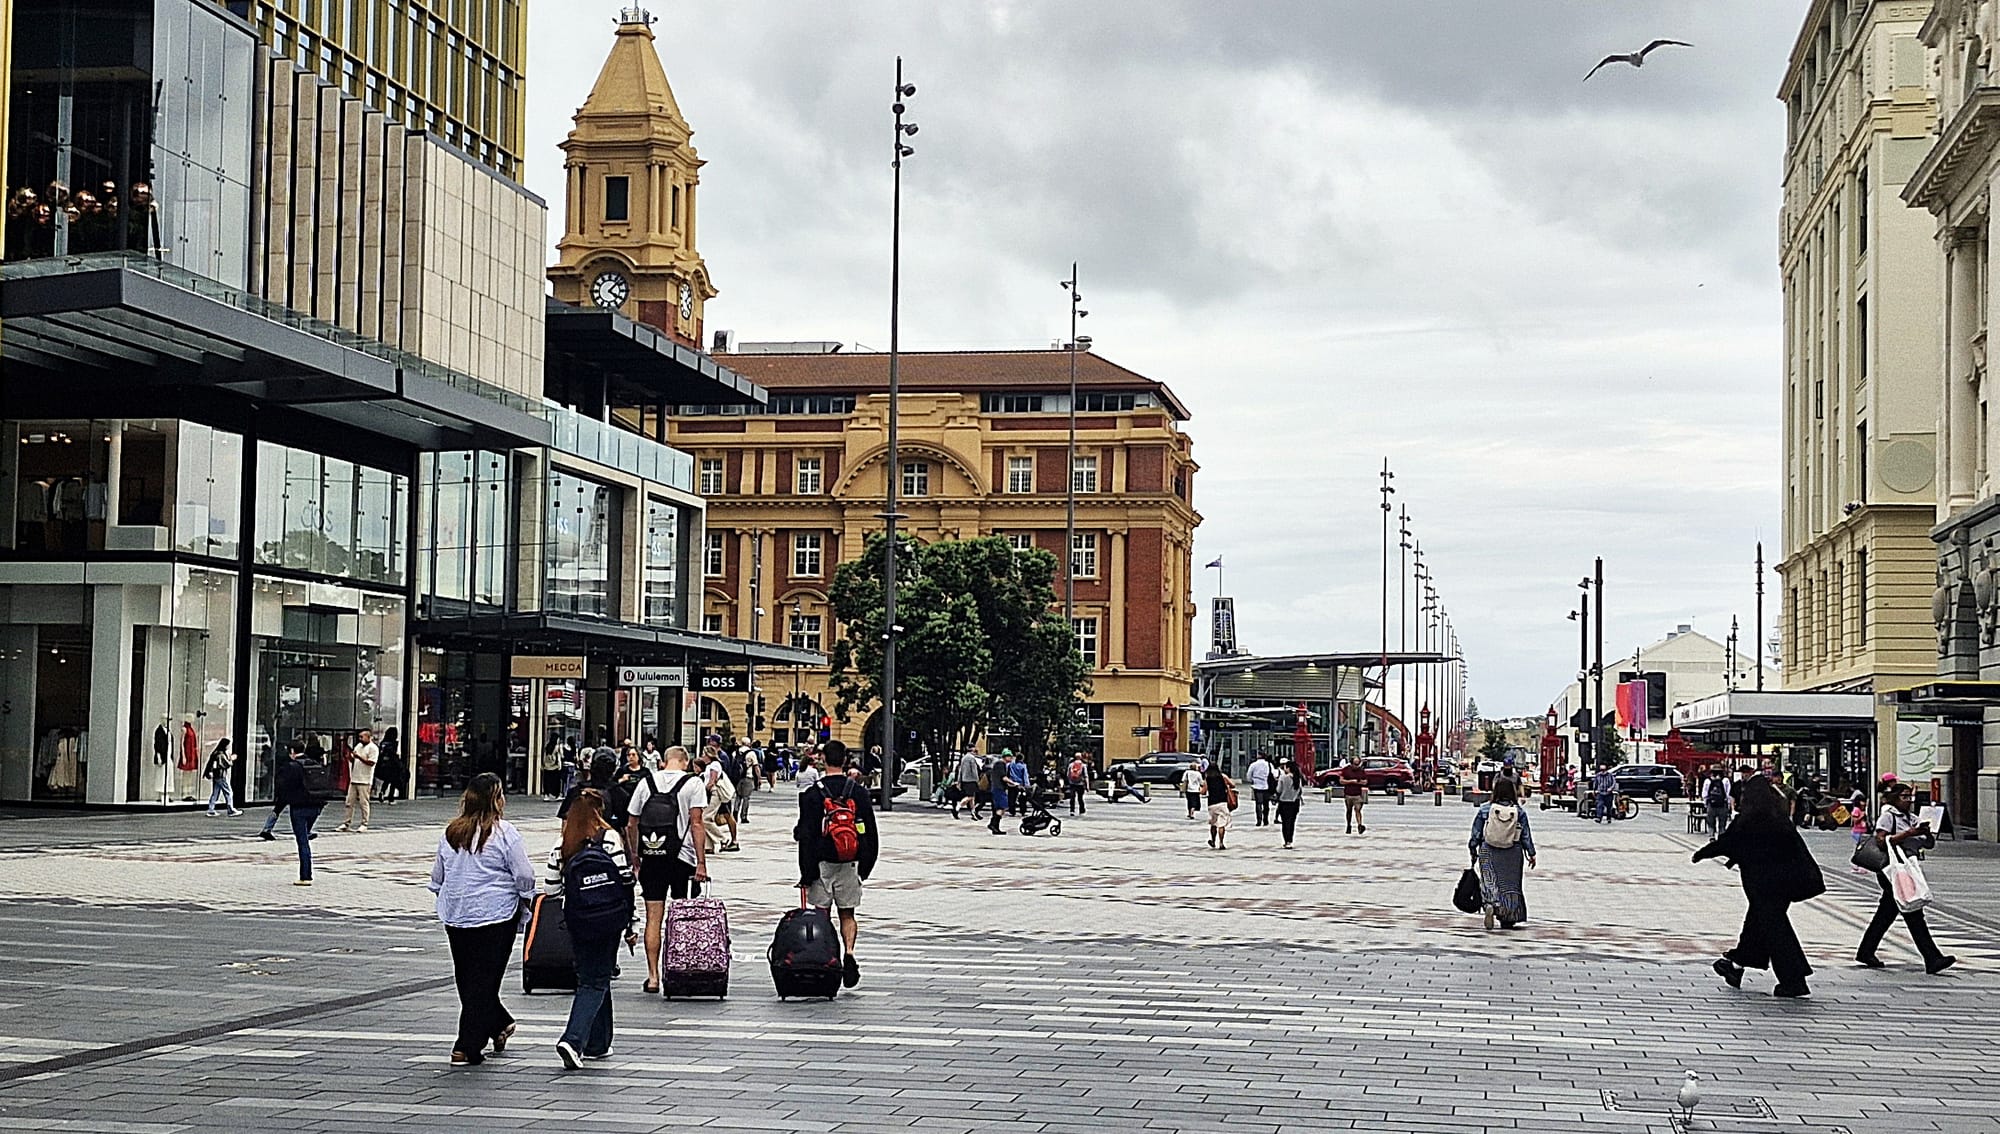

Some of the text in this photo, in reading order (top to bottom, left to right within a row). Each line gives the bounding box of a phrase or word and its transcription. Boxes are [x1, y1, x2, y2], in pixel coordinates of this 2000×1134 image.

[545, 663, 582, 671] MECCA
[637, 671, 681, 680] lululemon
[702, 677, 735, 687] BOSS
